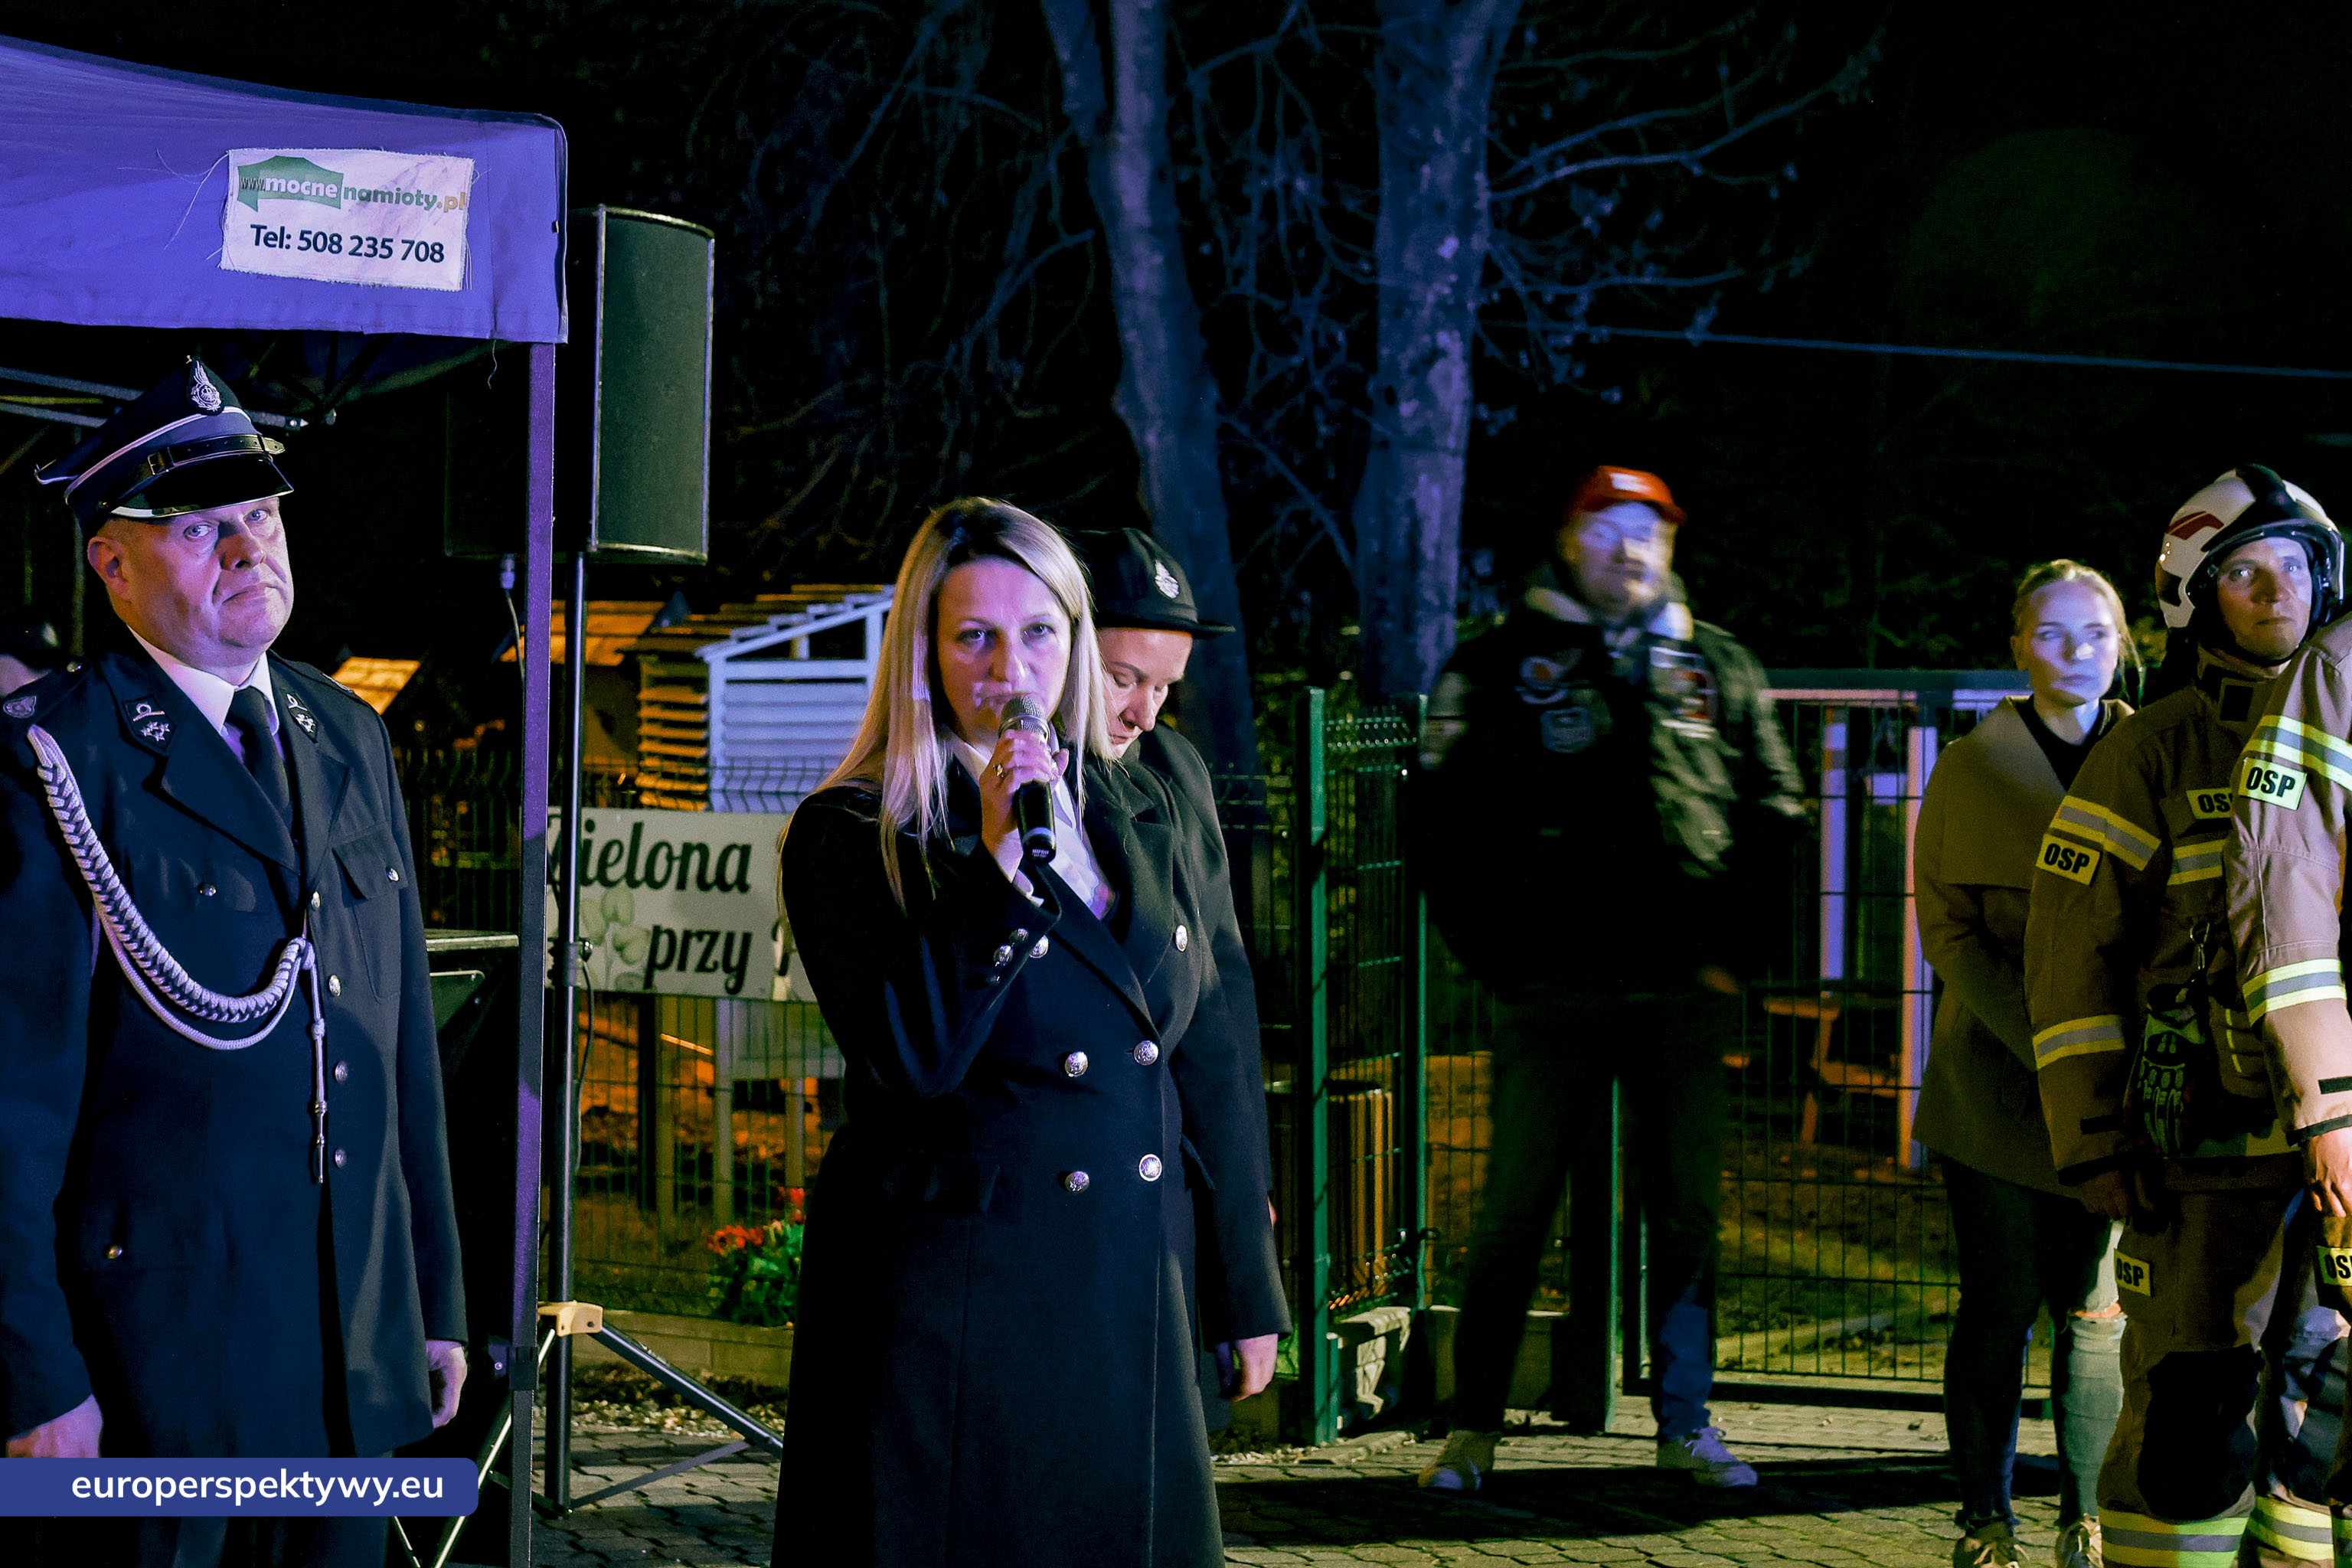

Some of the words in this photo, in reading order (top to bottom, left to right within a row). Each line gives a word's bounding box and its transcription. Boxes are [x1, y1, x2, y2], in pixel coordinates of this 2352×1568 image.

[239, 176, 466, 213] www.mocnenamioty.pl
[250, 224, 292, 250] Tel:
[297, 230, 343, 255] 508
[348, 235, 394, 259] 235
[400, 239, 445, 263] 708
[2245, 766, 2296, 799] OSP
[2043, 842, 2091, 875] OSP
[642, 923, 753, 995] przy
[2116, 1257, 2145, 1287] OSP
[2324, 1253, 2352, 1279] OS
